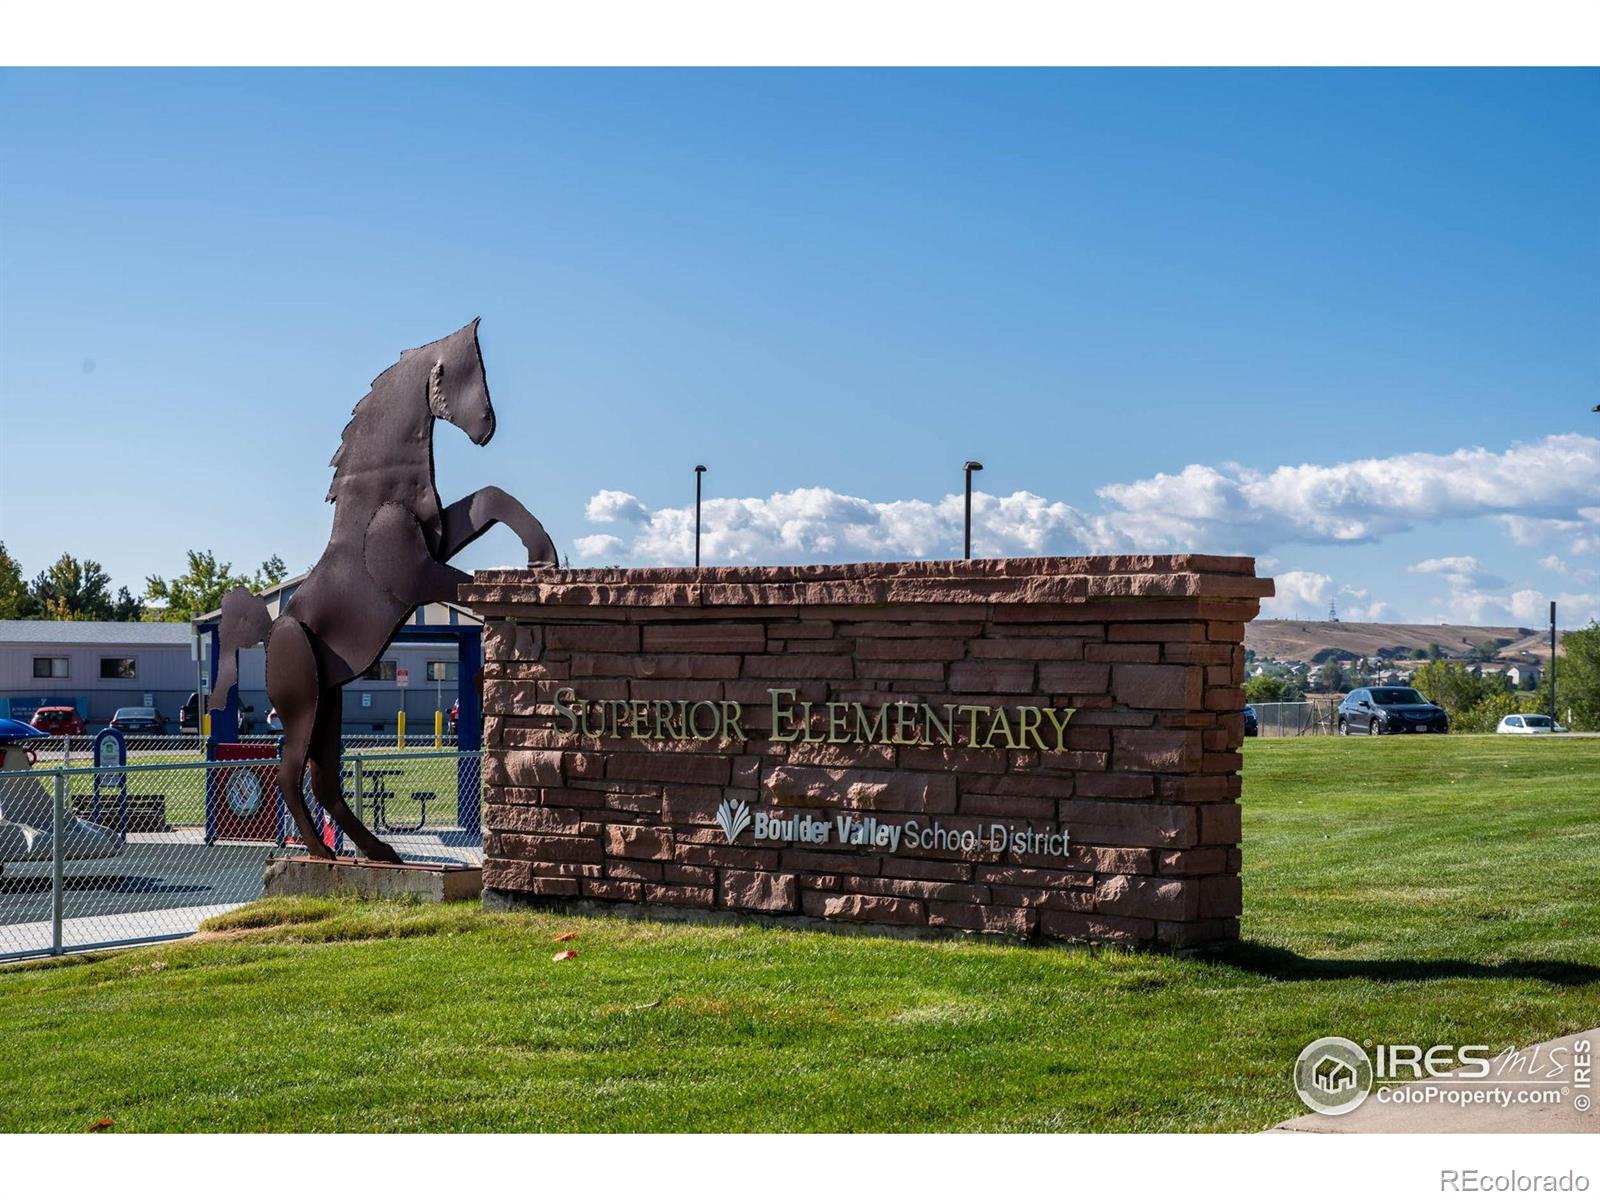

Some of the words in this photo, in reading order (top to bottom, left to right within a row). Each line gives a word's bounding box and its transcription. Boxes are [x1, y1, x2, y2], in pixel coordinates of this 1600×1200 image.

[552, 687, 748, 742] SUPERIOR
[766, 688, 1077, 751] ELEMENTARY
[754, 813, 831, 843] Boulder
[837, 815, 901, 852] Valley
[904, 820, 983, 851] School
[990, 824, 1071, 857] District
